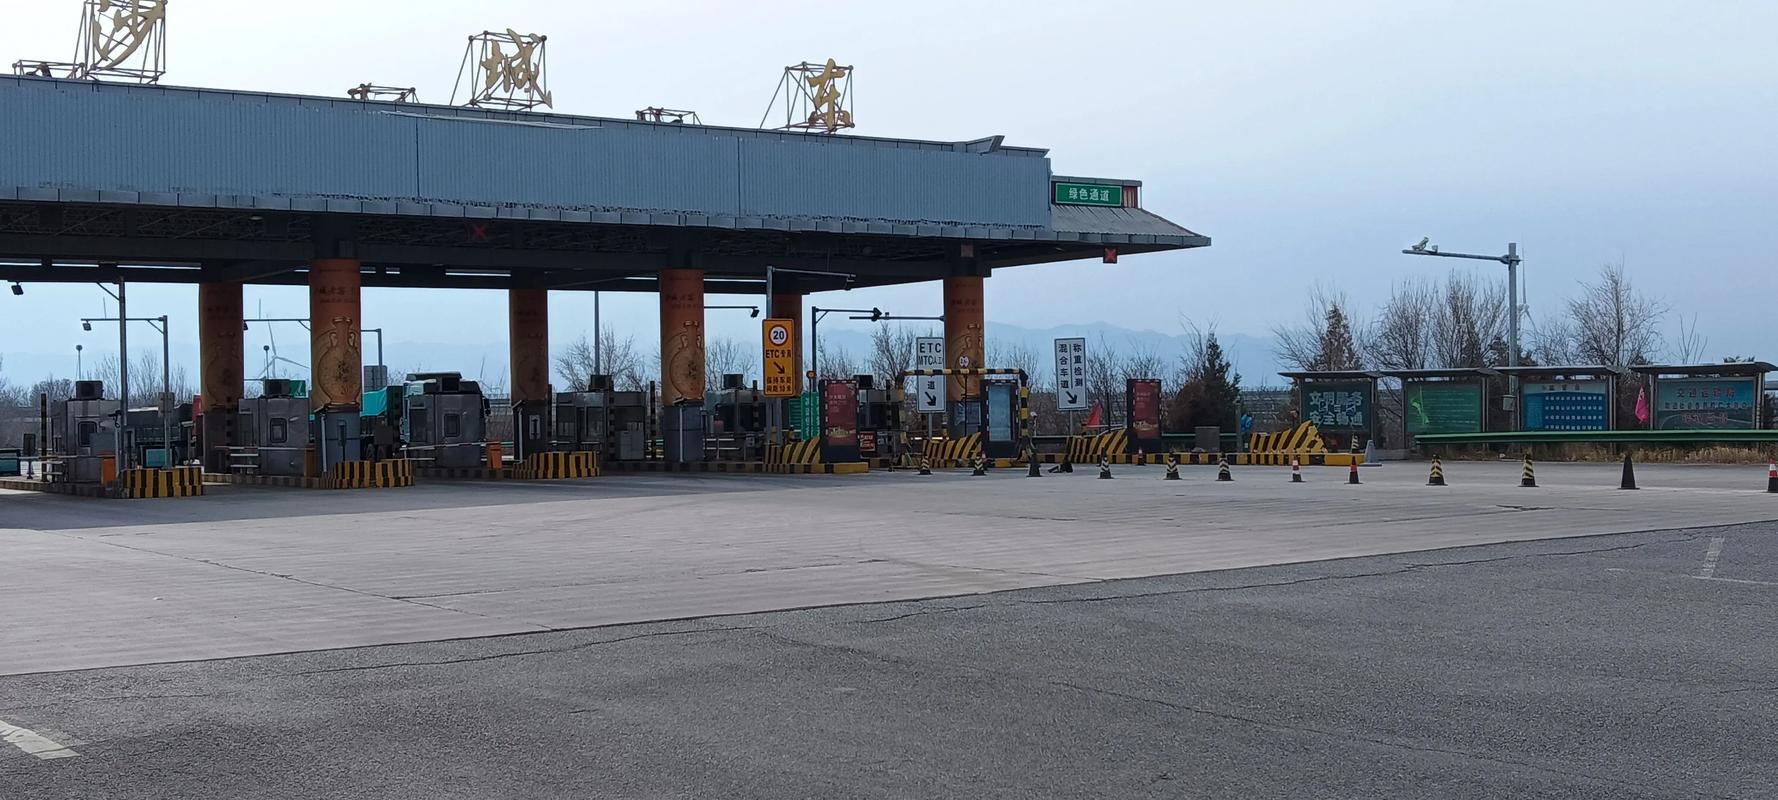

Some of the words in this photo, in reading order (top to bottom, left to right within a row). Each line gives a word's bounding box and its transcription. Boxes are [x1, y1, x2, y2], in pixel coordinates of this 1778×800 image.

[1068, 187, 1110, 202] 绿色通道
[773, 330, 785, 340] 20
[919, 343, 942, 353] ETC
[1059, 343, 1069, 389] 混合车道
[1073, 343, 1083, 387] 称重检测
[1309, 391, 1363, 406] 文明服务
[1309, 410, 1363, 426] 安全畅通
